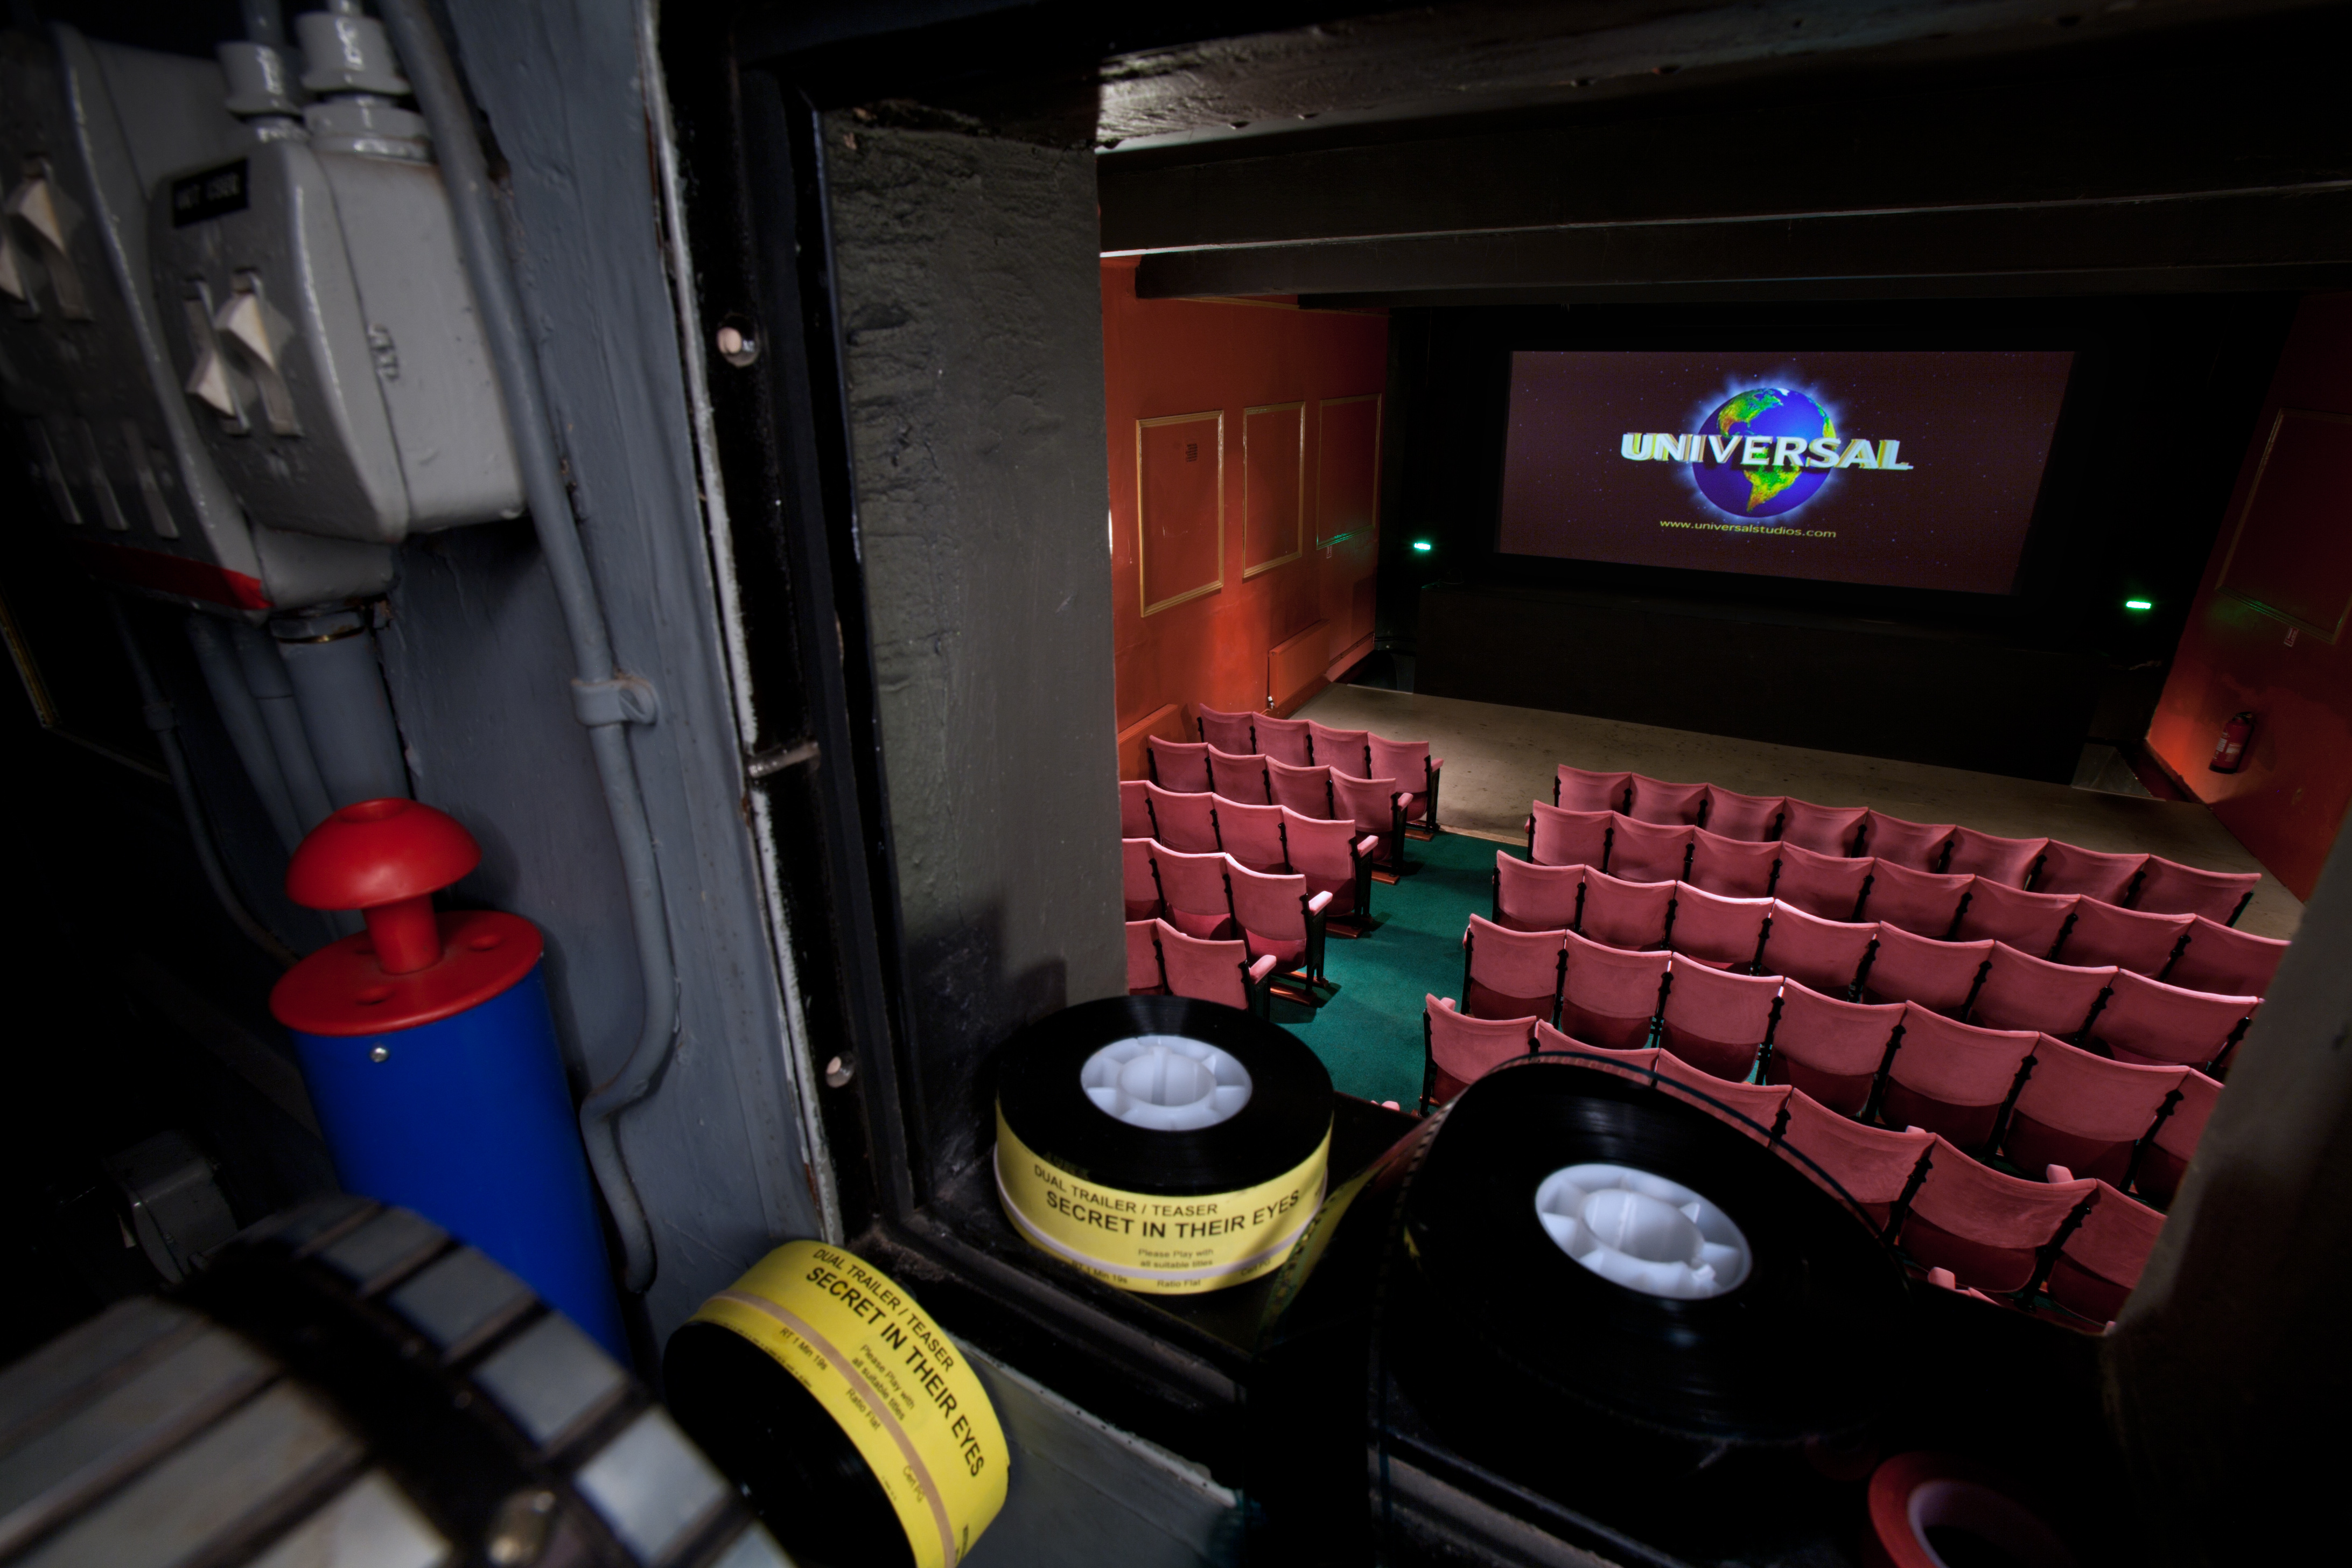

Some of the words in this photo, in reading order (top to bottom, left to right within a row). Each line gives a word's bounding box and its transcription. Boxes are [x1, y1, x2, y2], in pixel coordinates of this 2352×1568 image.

[1621, 432, 1914, 471] UNIVERSAL
[1660, 520, 1837, 538] www.universalstudios.com
[1034, 1164, 1067, 1193] DUAL
[1072, 1184, 1136, 1213] TRAILER
[1141, 1203, 1147, 1214] /
[1151, 1203, 1217, 1217] TEASER
[1047, 1190, 1135, 1234] SECRET
[1143, 1221, 1166, 1238] IN
[1175, 1215, 1245, 1238] THEIR
[1252, 1189, 1299, 1225] EYES
[1138, 1248, 1170, 1258] Please
[1173, 1250, 1193, 1259] Play
[1195, 1248, 1214, 1256] with
[1153, 1259, 1189, 1269] suitable
[1192, 1259, 1213, 1267] titles
[1157, 1279, 1181, 1287] Ratio
[1184, 1278, 1201, 1286] Flat
[813, 1249, 845, 1270] DUAL
[847, 1264, 901, 1310] TRAILER
[898, 1307, 909, 1316] /
[907, 1313, 954, 1372] TEASER
[780, 1327, 794, 1339] RT
[798, 1341, 813, 1358] Min
[806, 1267, 886, 1325] SECRET
[880, 1322, 908, 1350] IN
[906, 1345, 957, 1418] THEIR
[951, 1413, 984, 1477] EYES
[852, 1357, 864, 1368] all
[862, 1367, 889, 1399] suitable
[888, 1397, 905, 1421] titles
[860, 1344, 885, 1373] Please
[885, 1371, 906, 1391] Play
[900, 1390, 915, 1410] with
[846, 1388, 866, 1412] Ratio
[865, 1410, 881, 1431] Flat
